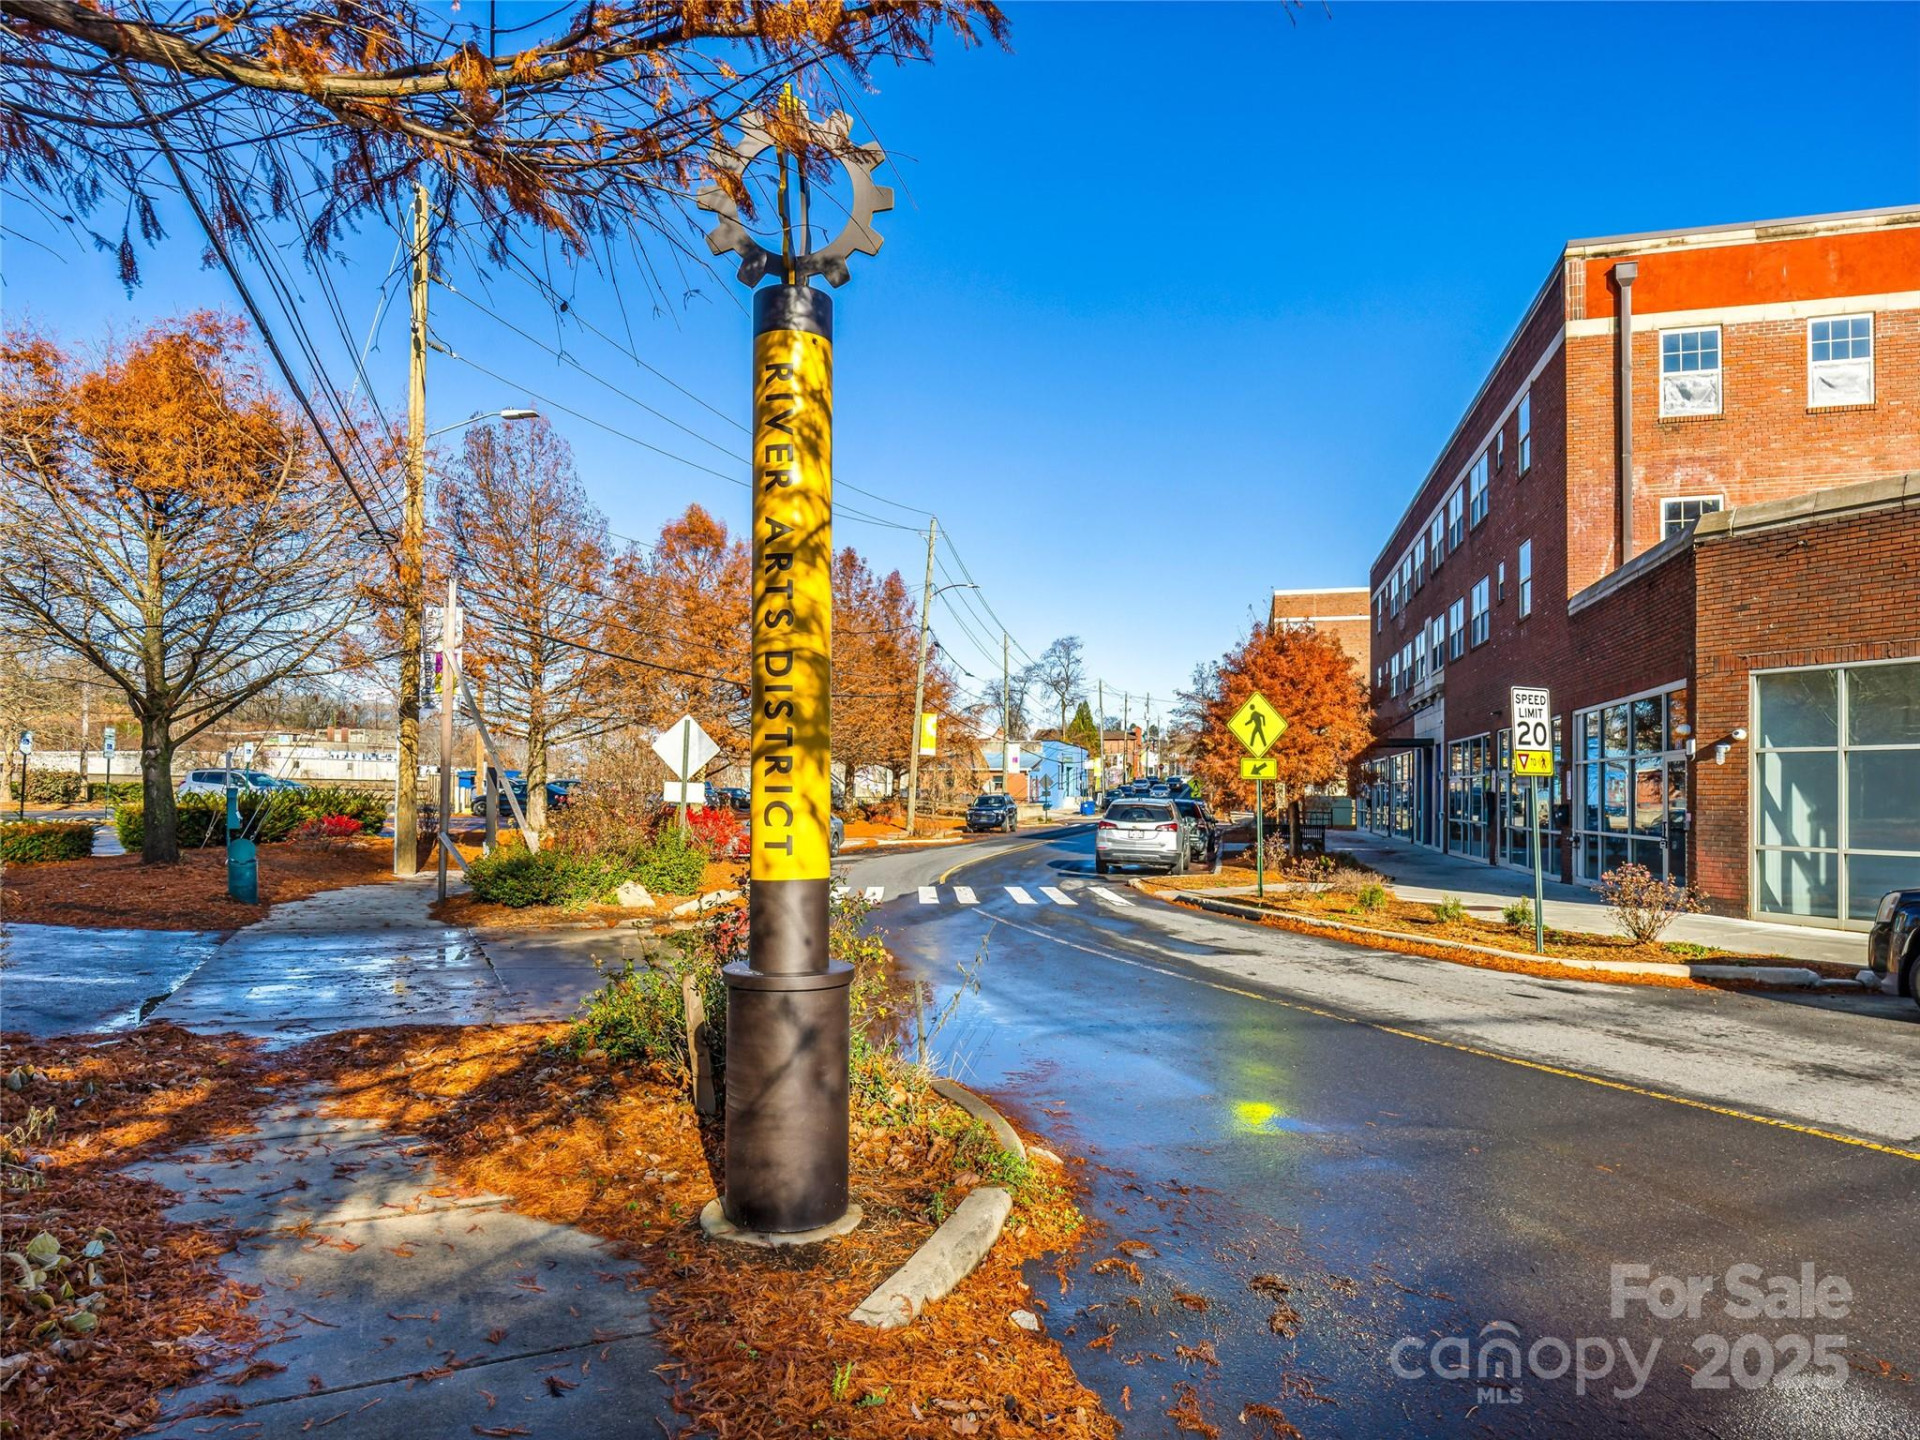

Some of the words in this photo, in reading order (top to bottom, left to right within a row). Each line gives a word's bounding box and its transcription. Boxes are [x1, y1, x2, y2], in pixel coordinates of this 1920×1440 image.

[764, 362, 794, 492] RIVER
[764, 516, 794, 629] ARTS
[1515, 694, 1546, 706] SPEED
[1517, 721, 1547, 746] 20
[1518, 708, 1543, 719] LIMIT
[764, 650, 794, 856] DISTRICT
